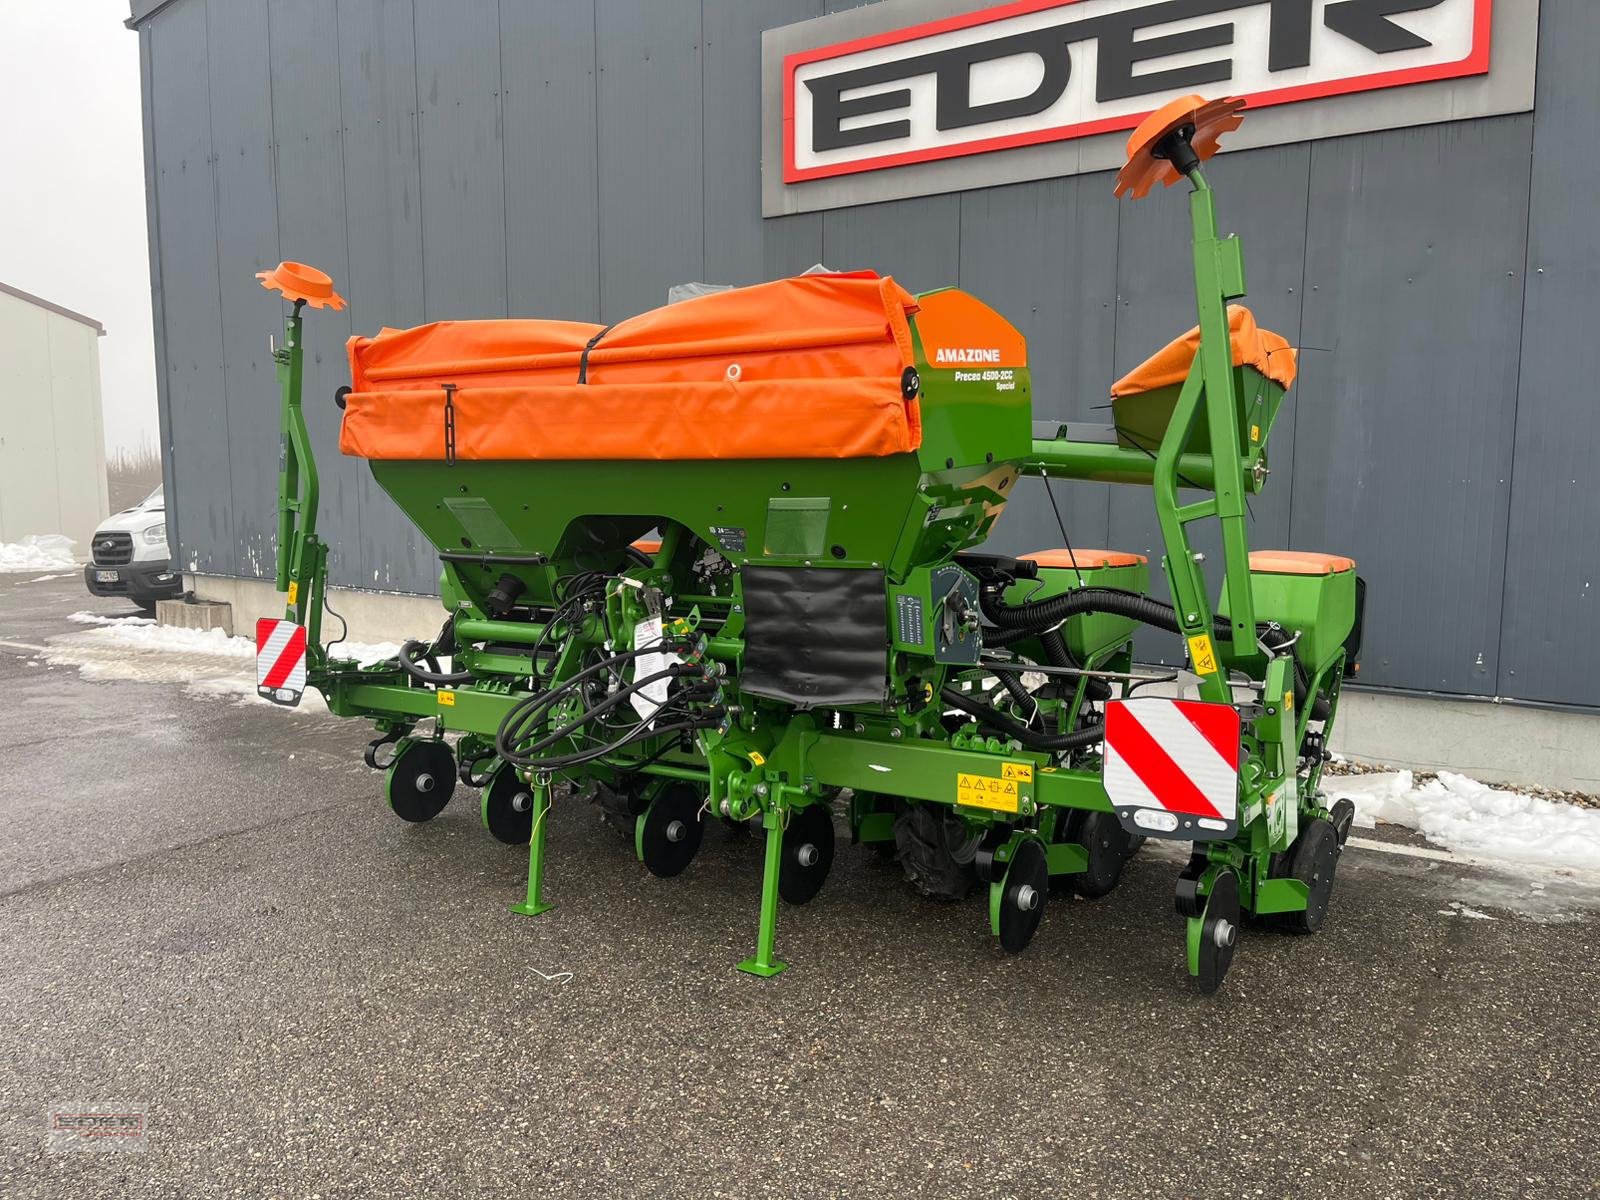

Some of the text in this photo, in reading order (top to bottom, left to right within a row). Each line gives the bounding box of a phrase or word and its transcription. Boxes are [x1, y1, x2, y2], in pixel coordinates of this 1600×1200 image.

[803, 0, 1445, 152] EDER
[936, 348, 1000, 363] AMAZONE
[955, 370, 1013, 382] Precea 4500-2CC
[996, 382, 1015, 392] Special
